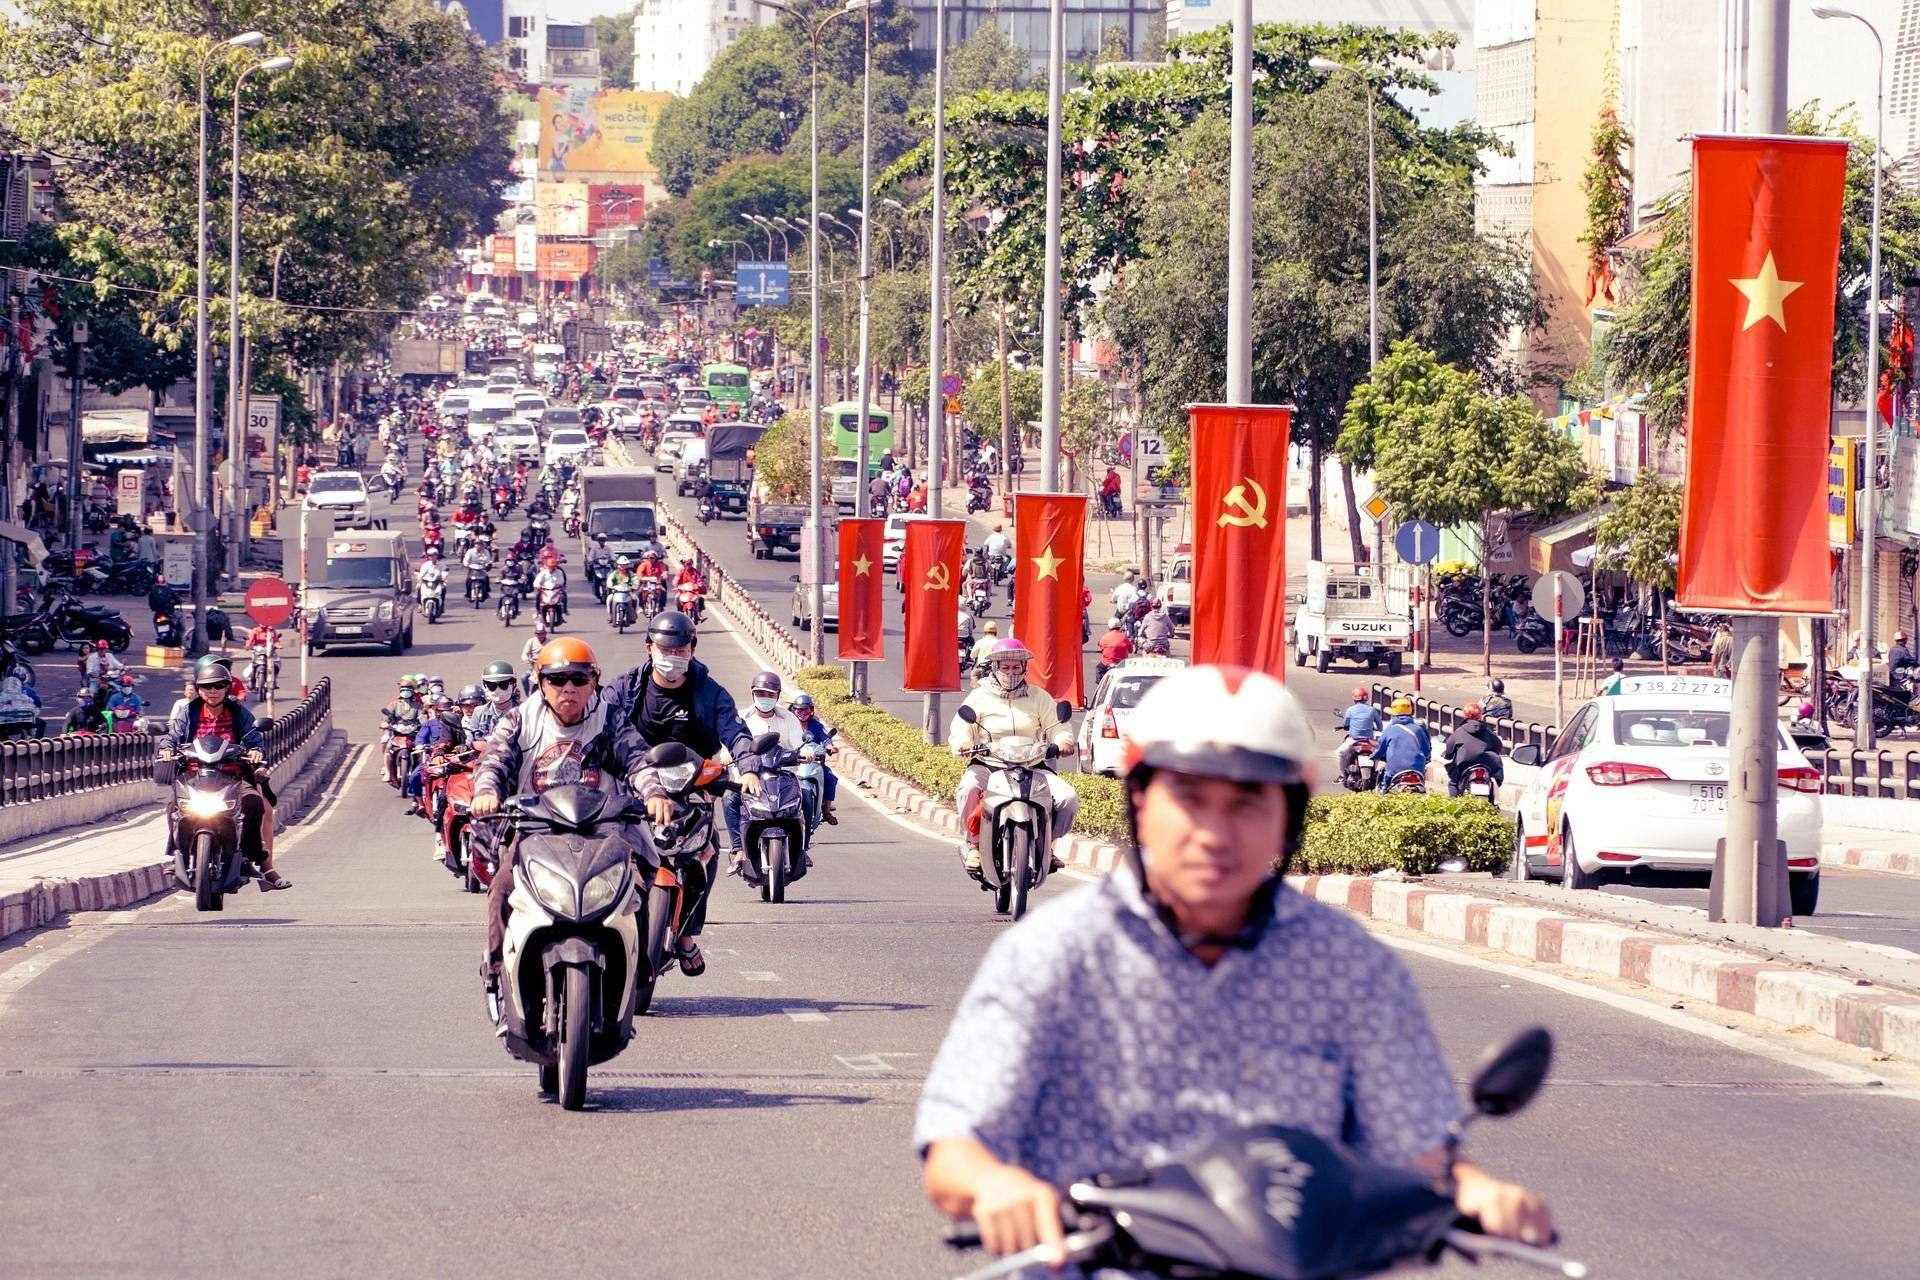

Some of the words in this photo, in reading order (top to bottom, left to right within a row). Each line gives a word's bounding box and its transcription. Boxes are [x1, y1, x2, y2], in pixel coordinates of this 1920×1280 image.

[250, 415, 268, 428] 30
[1141, 440, 1160, 455] 12
[1342, 622, 1392, 632] SUZUKI
[1671, 682, 1687, 692] 27
[1692, 683, 1709, 693] 27
[1713, 684, 1729, 694] 27
[1700, 786, 1724, 799] 51G
